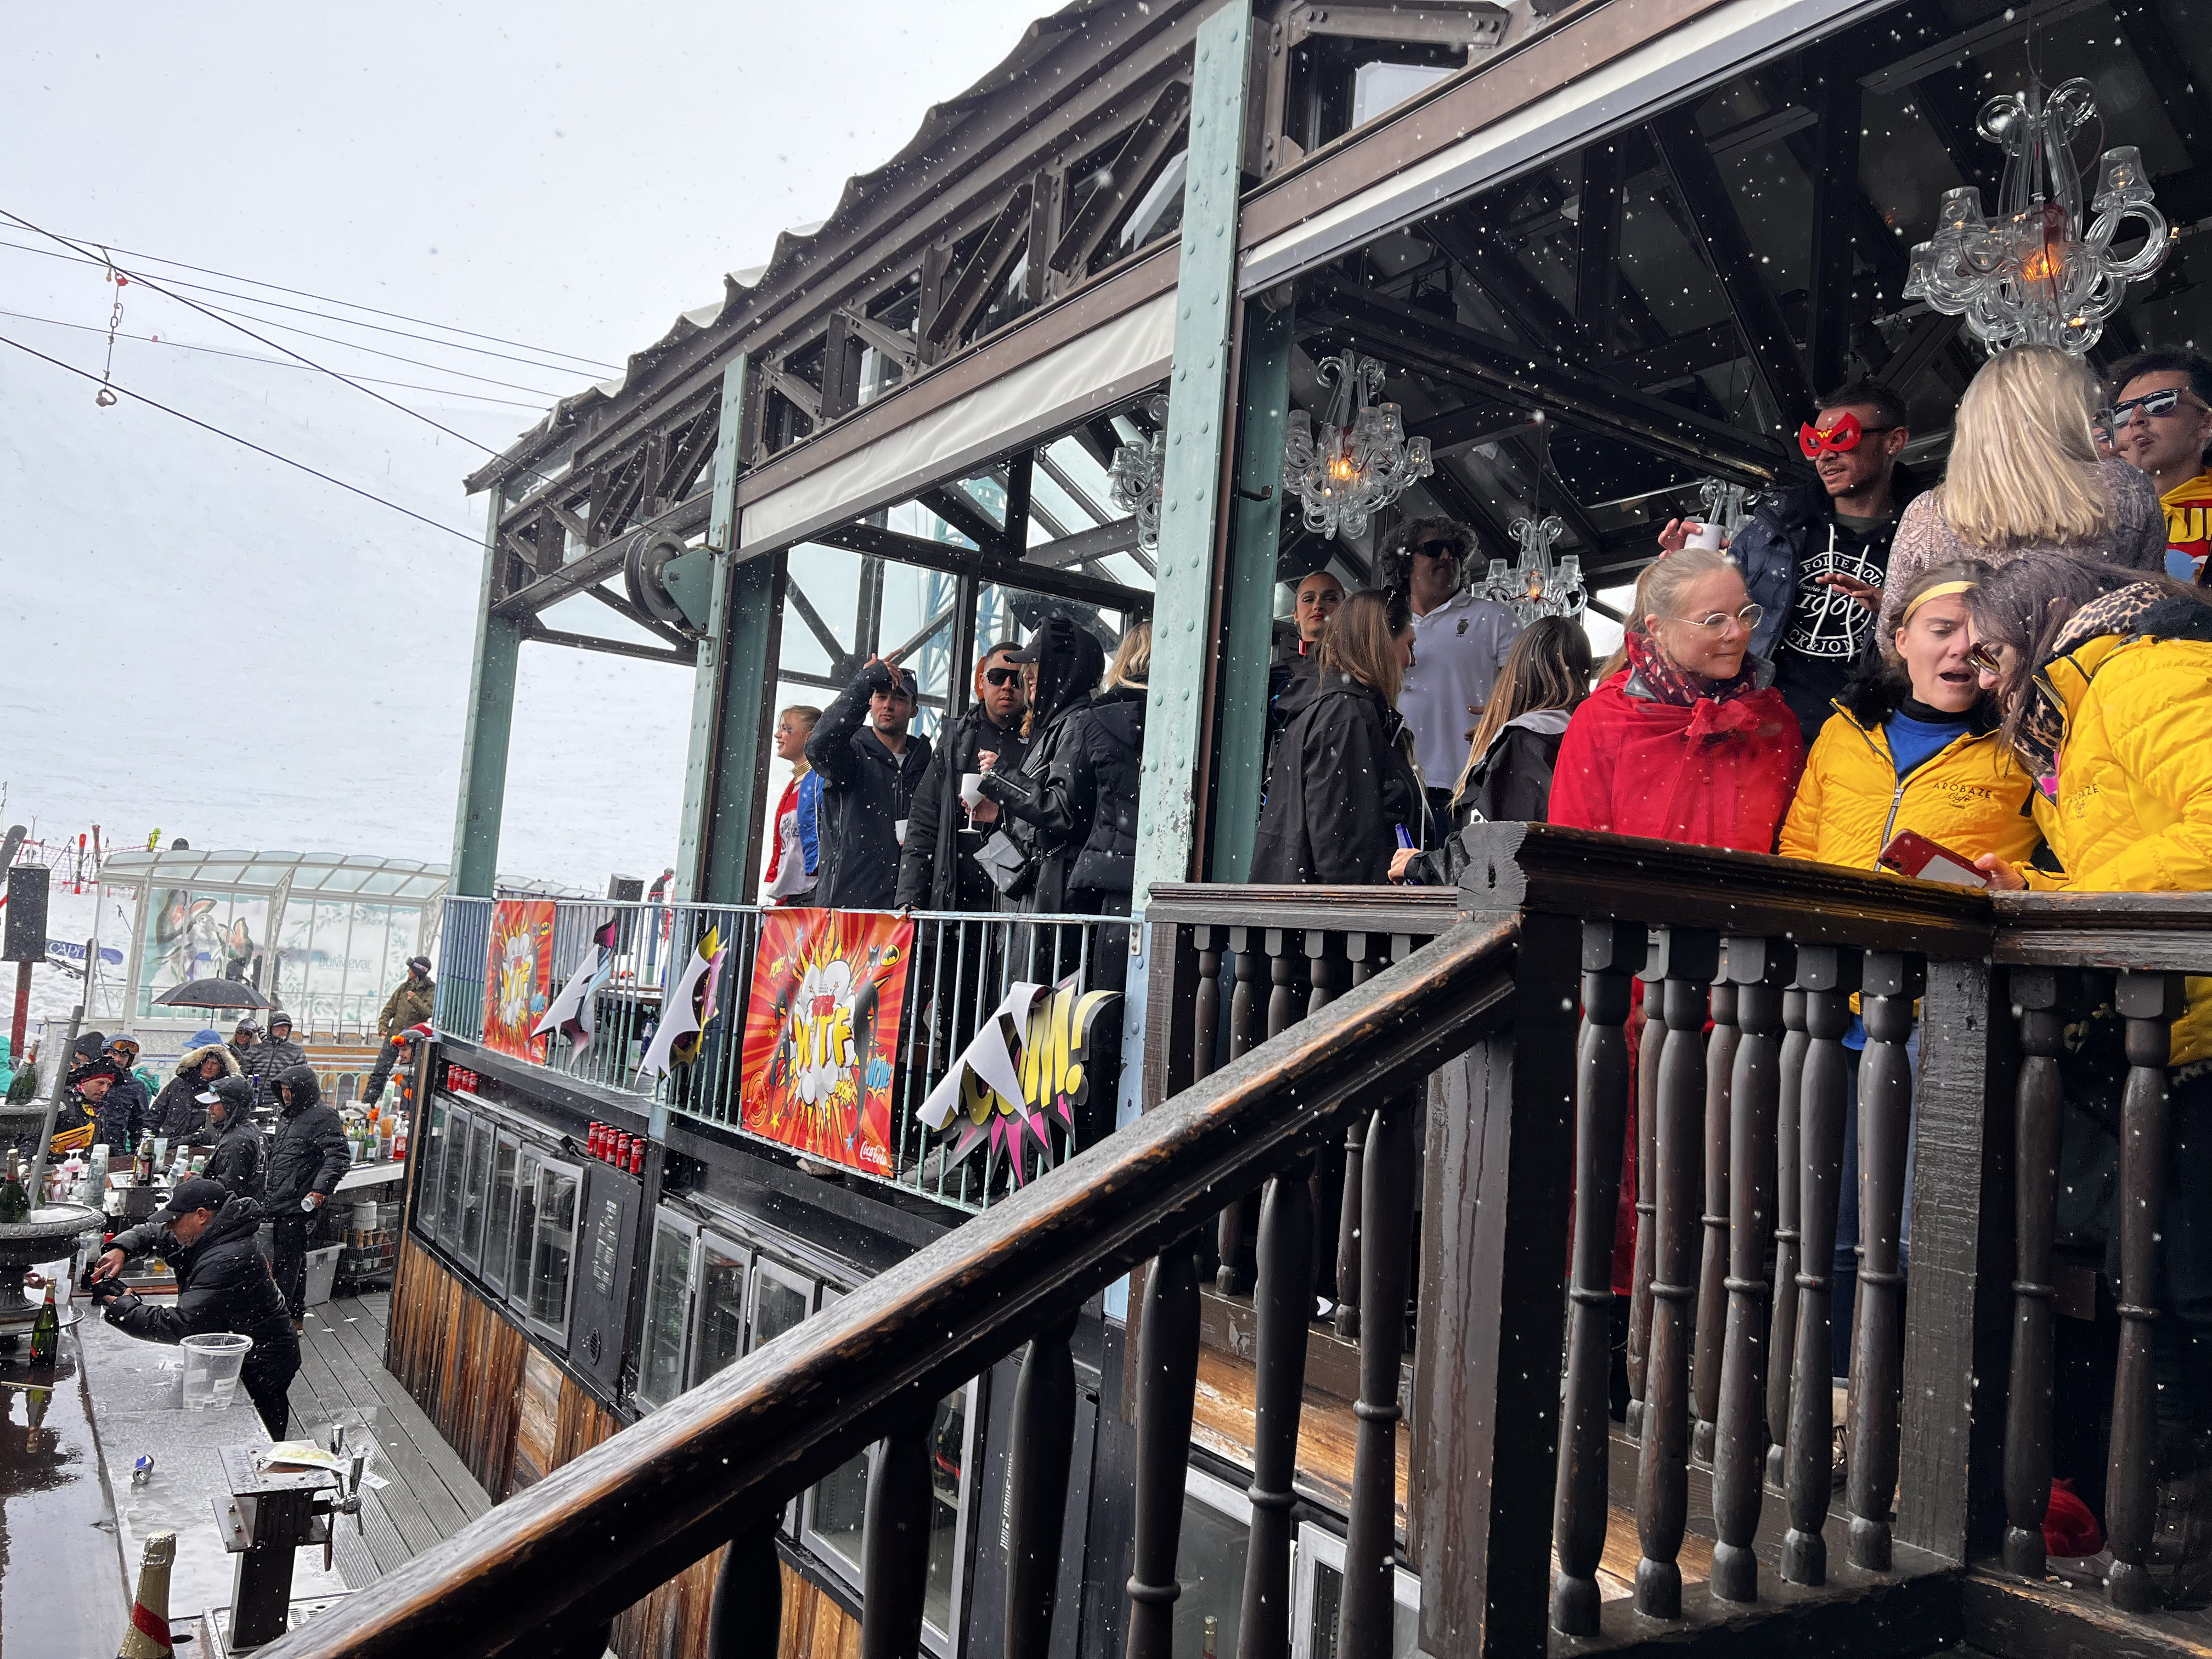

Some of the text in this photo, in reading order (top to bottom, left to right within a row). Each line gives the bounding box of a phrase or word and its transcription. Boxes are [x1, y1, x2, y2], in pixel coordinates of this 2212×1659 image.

[1803, 556, 1882, 588] FOLIE DOU
[1933, 782, 1992, 799] AROBAZE
[794, 1006, 851, 1070] WTF
[866, 1057, 893, 1091] WOW!
